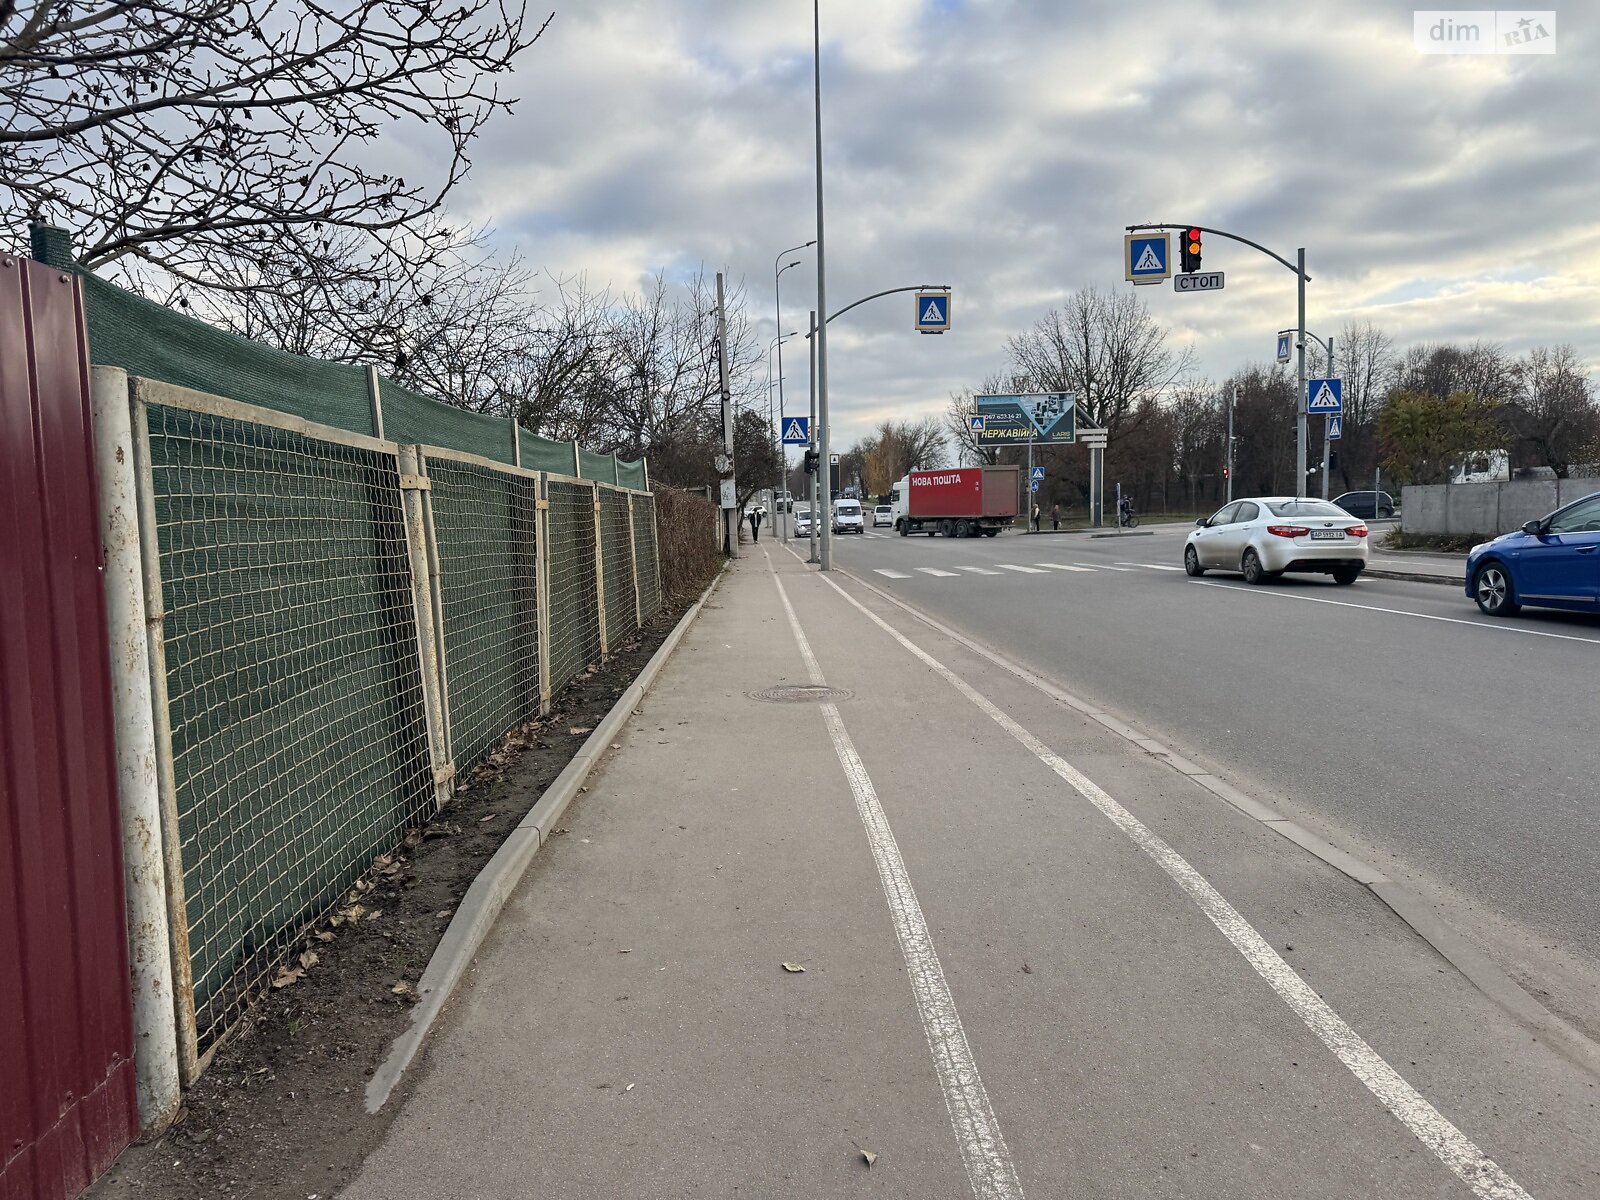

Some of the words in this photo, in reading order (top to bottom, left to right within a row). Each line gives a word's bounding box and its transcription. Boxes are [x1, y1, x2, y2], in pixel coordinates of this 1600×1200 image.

[1180, 275, 1219, 289] СТОП
[912, 476, 932, 486] НОВА
[933, 474, 961, 485] ПОШТА
